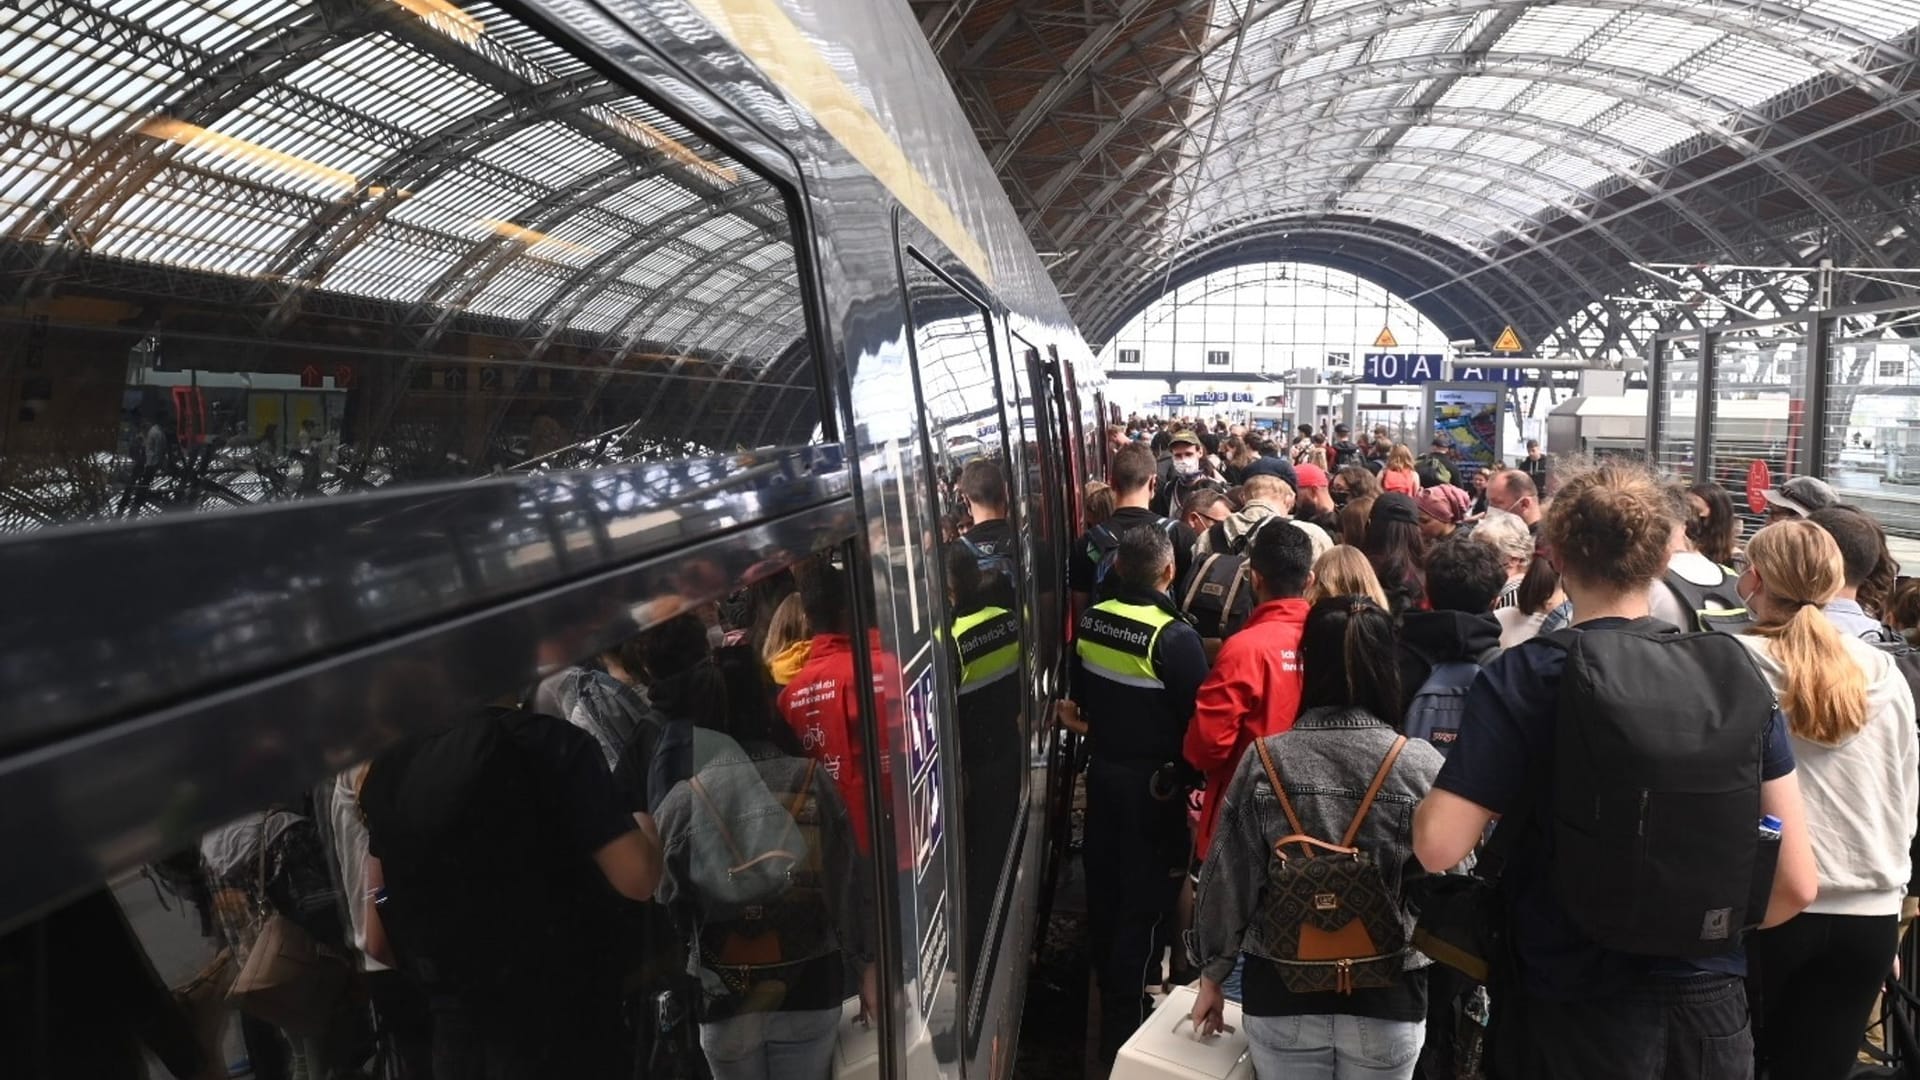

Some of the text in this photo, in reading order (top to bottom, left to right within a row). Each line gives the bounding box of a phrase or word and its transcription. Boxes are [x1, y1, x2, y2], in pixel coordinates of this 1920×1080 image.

[1125, 351, 1135, 361] 10
[1214, 352, 1224, 363] 11
[1369, 355, 1431, 378] 10 A
[1080, 616, 1148, 646] DB Sicherheit
